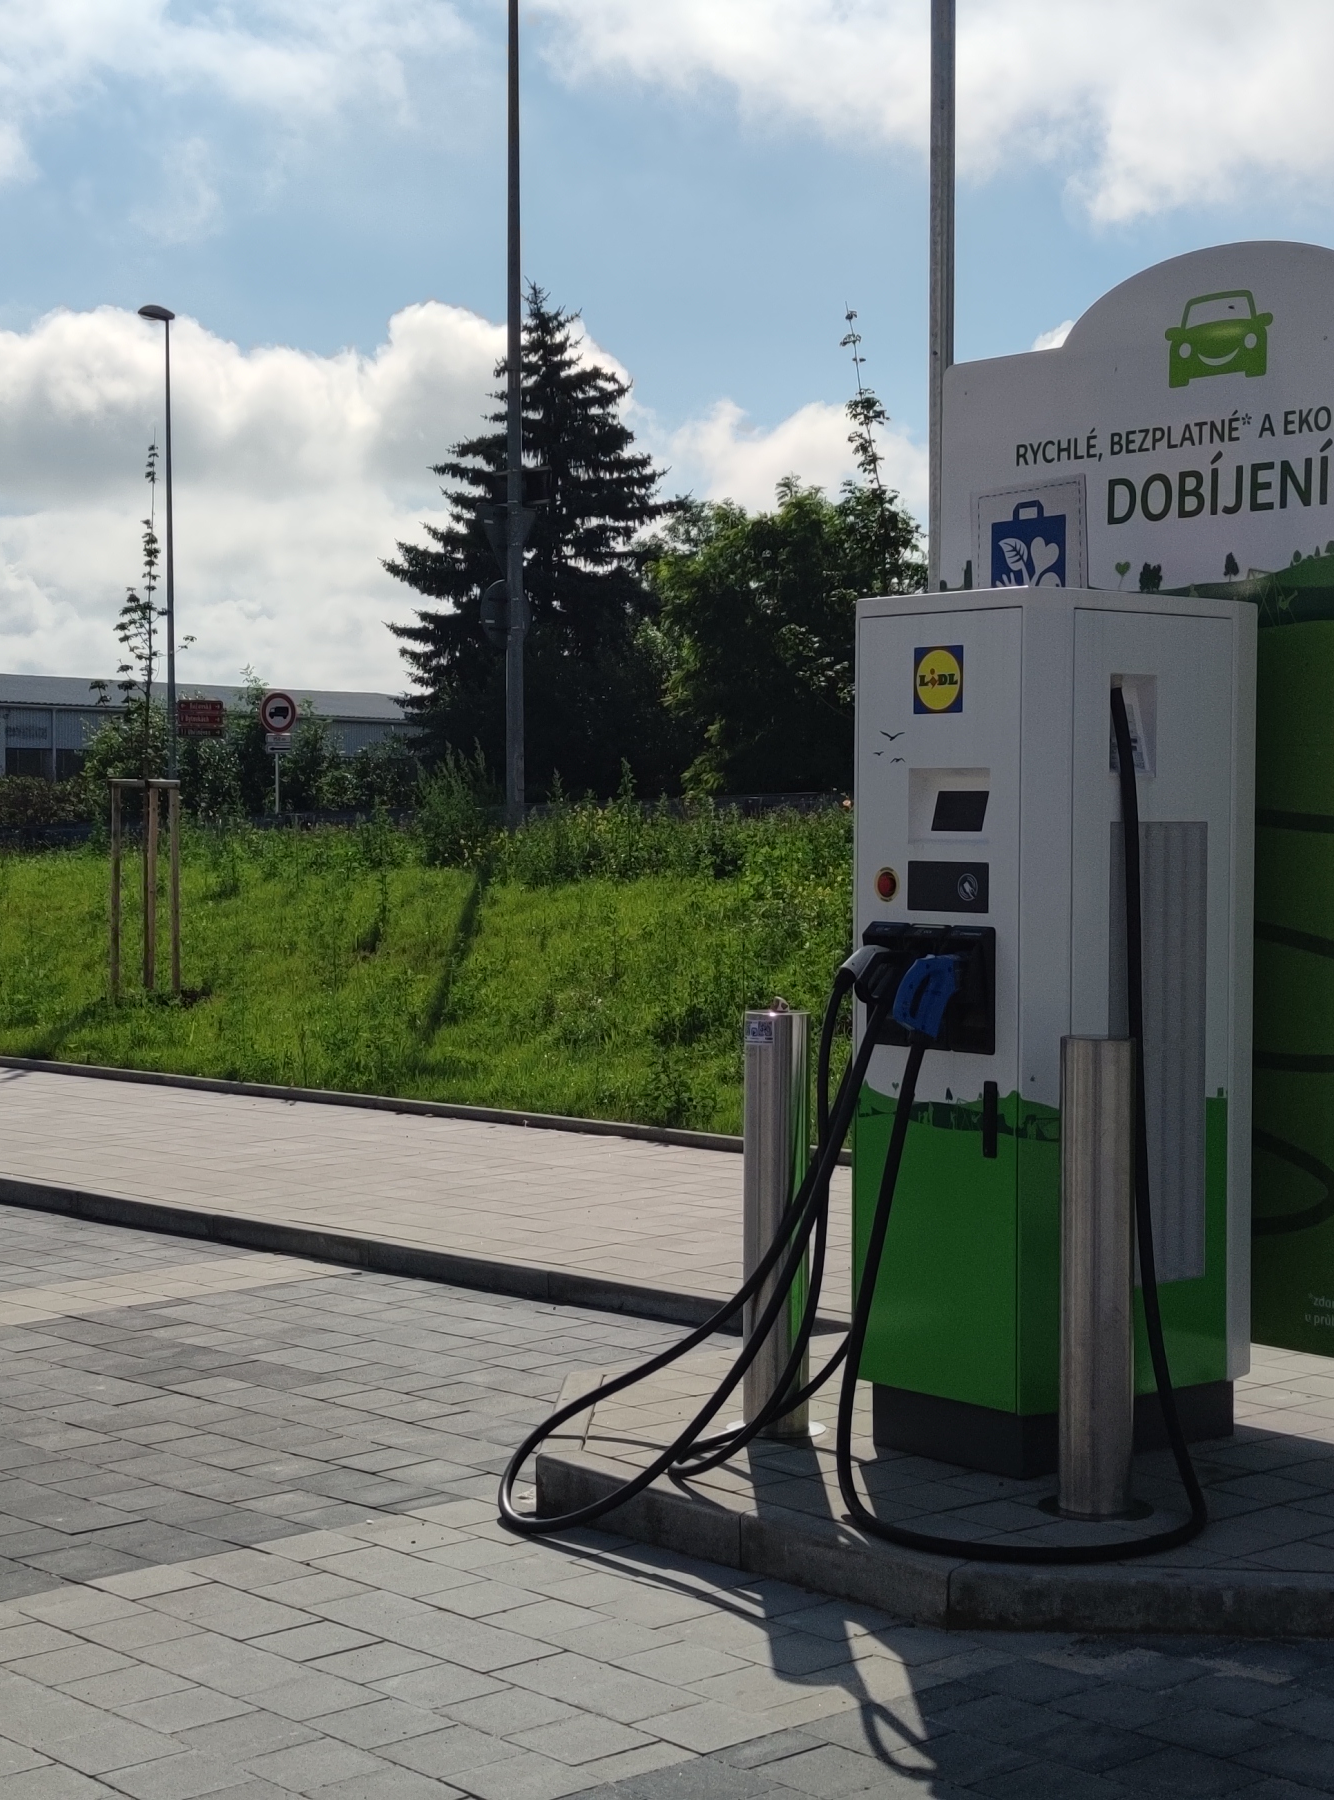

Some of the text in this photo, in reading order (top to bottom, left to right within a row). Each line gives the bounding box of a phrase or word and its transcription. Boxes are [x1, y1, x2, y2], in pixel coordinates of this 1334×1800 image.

[1016, 427, 1103, 467] RYCHLÉ,
[1258, 413, 1276, 438] A
[1107, 437, 1333, 525] DOBÍJENÍ
